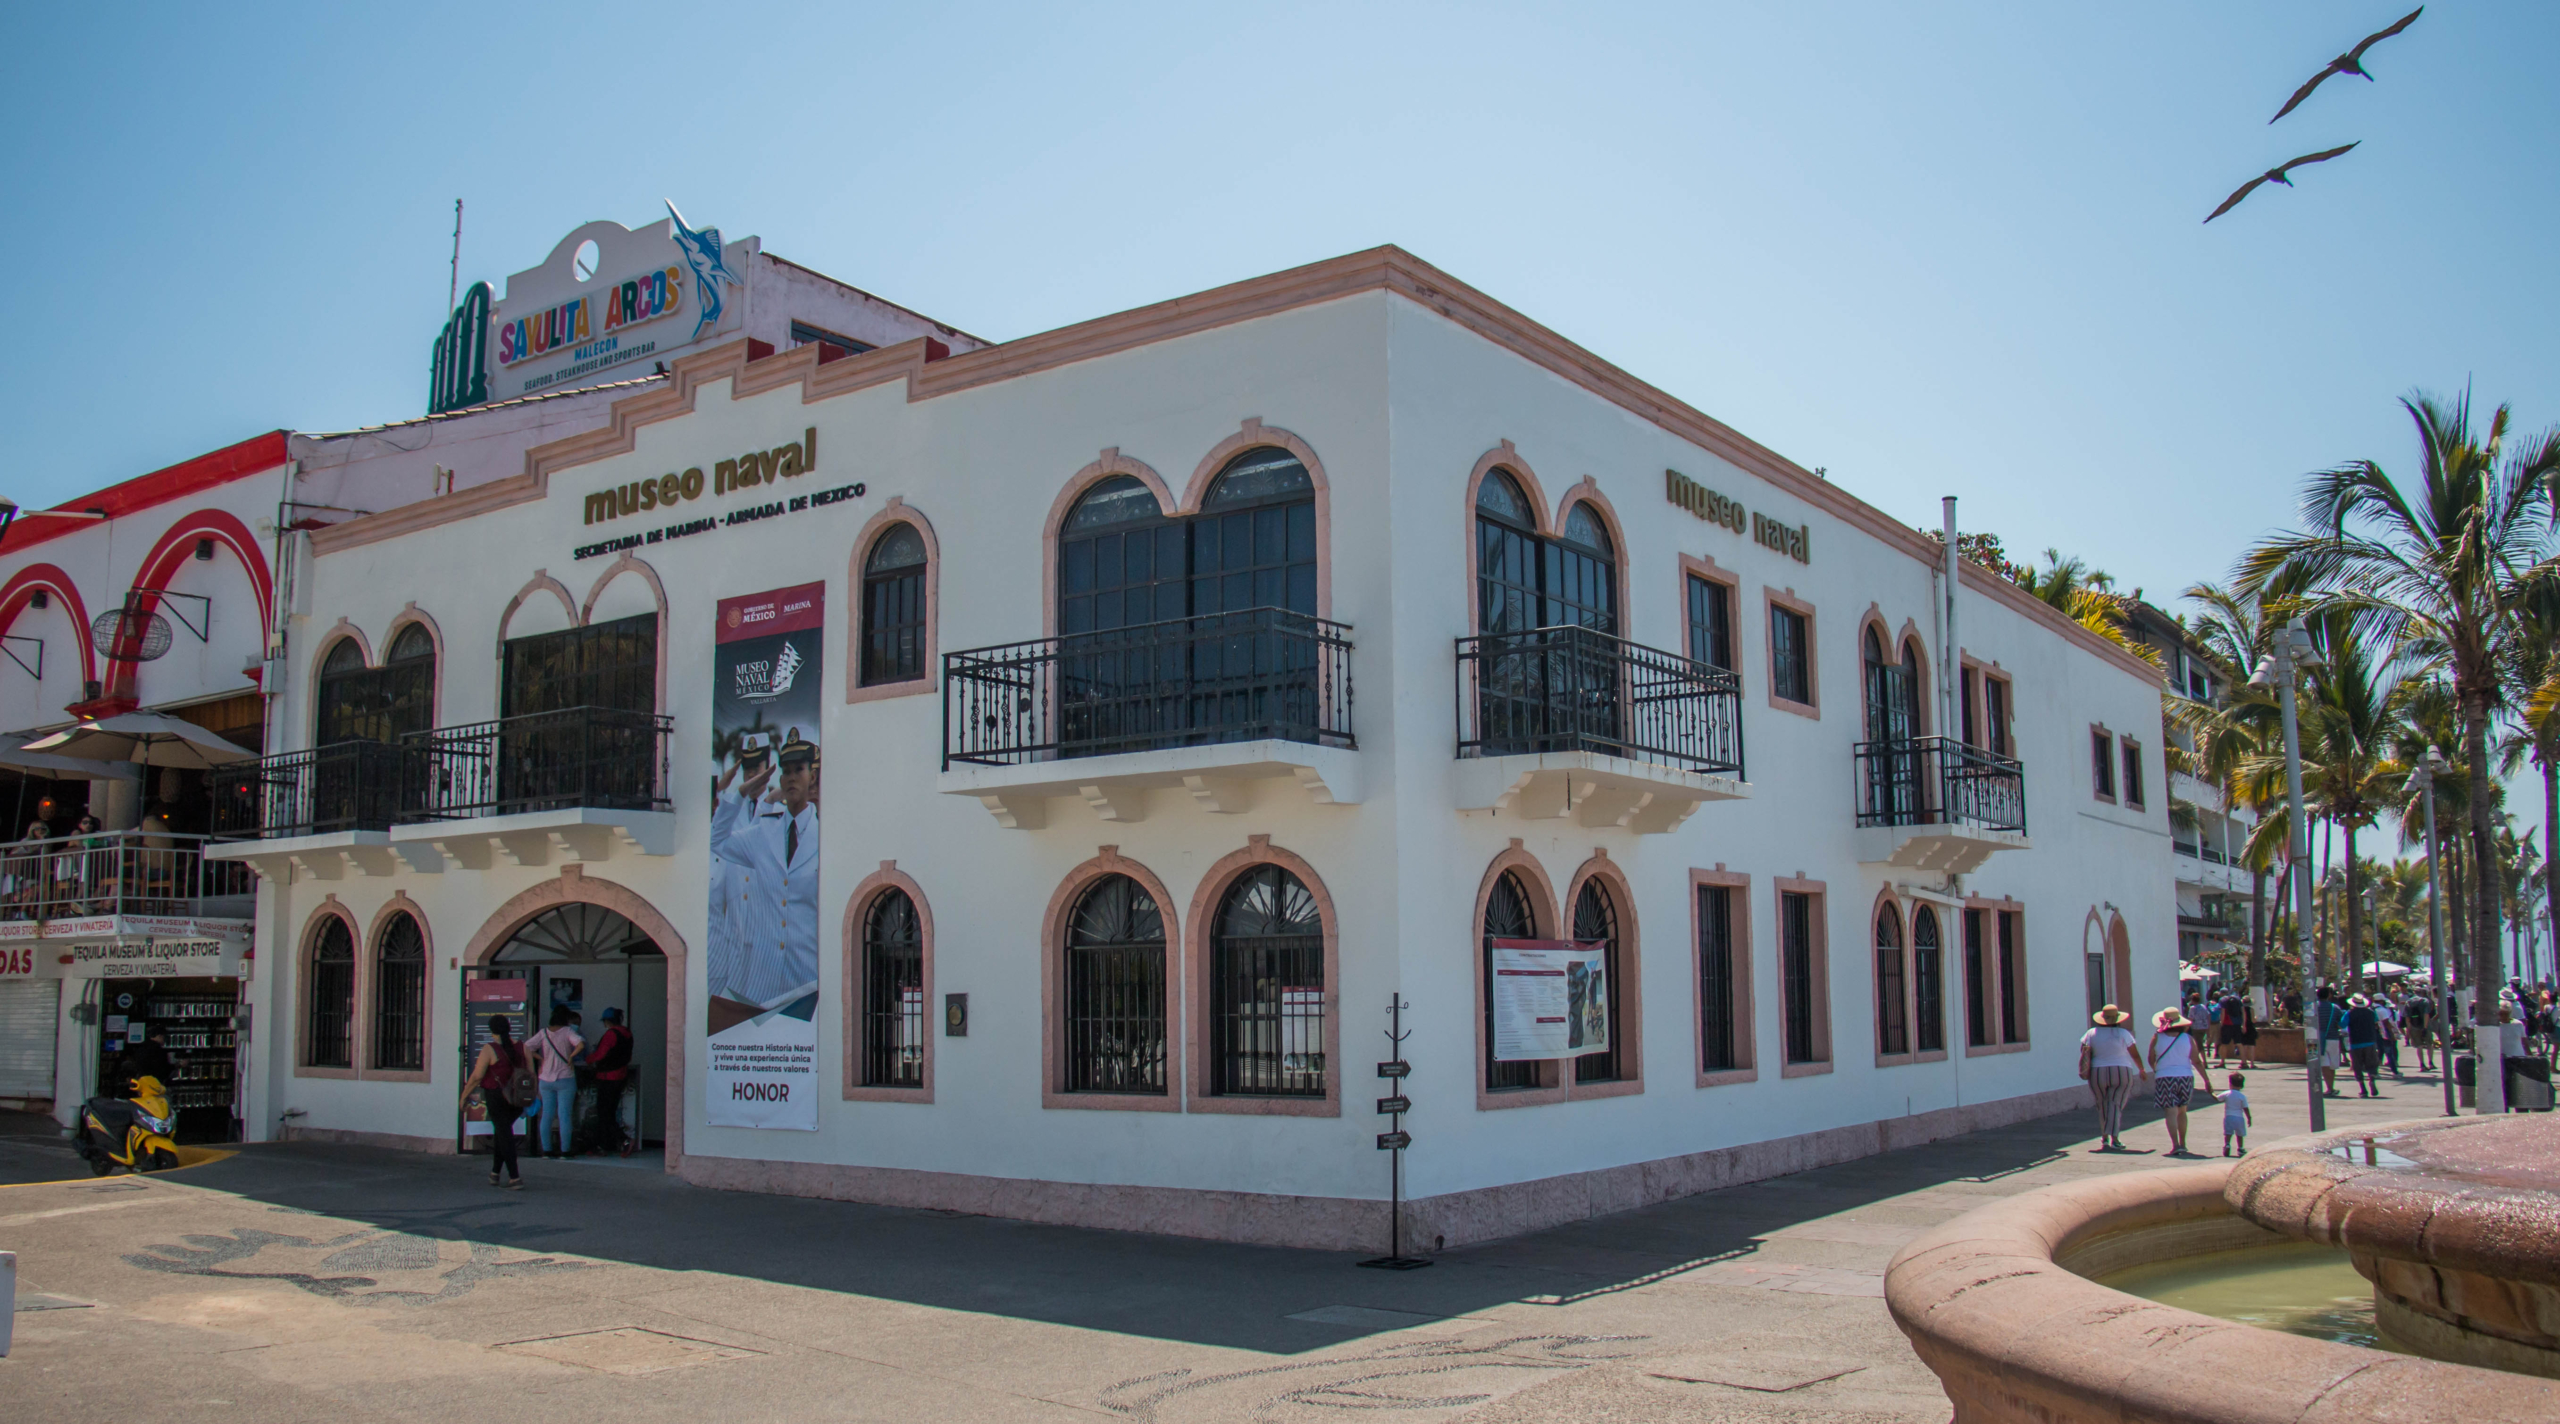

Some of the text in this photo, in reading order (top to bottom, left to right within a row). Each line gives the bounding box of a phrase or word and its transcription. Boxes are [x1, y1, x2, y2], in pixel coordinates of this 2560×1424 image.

[499, 266, 680, 364] SAYULITA ARCOS
[574, 337, 618, 361] MALECON
[556, 359, 599, 381] STEAKHOUSE
[600, 354, 613, 367] AND
[614, 345, 641, 362] SPORTS
[642, 341, 656, 355] BAR
[584, 427, 817, 525] museo naval
[573, 533, 644, 561] SECRETARIA
[646, 529, 663, 545] DE
[666, 517, 717, 540] MARINA
[726, 502, 786, 527] ARMADA
[789, 497, 808, 513] DE
[811, 482, 866, 508] MEXICO
[1666, 468, 1811, 565] museo naval
[783, 600, 811, 612] MARINA
[743, 611, 775, 623] MÉXICO
[736, 660, 769, 676] MUSEO
[736, 671, 770, 688] NAVAL
[750, 696, 777, 705] VALLARTA
[44, 923, 73, 935] CERVEZA
[75, 924, 79, 932] Y
[80, 918, 114, 931] VINATERÍA
[120, 915, 154, 924] TEQUILA
[156, 918, 191, 927] MUSEUM
[200, 922, 228, 932] LIQUOR
[148, 926, 182, 934] CERVEZA
[74, 945, 108, 961] TEQUILA
[109, 943, 145, 959] MUSEUM
[155, 943, 190, 960] LIQUOR
[190, 941, 220, 957] STORE
[103, 960, 178, 976] CERVEZA Y VINATERÍA
[712, 1043, 814, 1052] Conoce nuestra Historia Naval
[714, 1054, 719, 1062] y
[720, 1053, 733, 1061] vive
[749, 1053, 789, 1063] experiencia
[791, 1054, 811, 1063] única
[720, 1063, 740, 1071] través
[741, 1063, 750, 1071] de
[752, 1064, 782, 1073] nuestros
[783, 1065, 809, 1073] valores
[732, 1082, 790, 1102] HONOR
